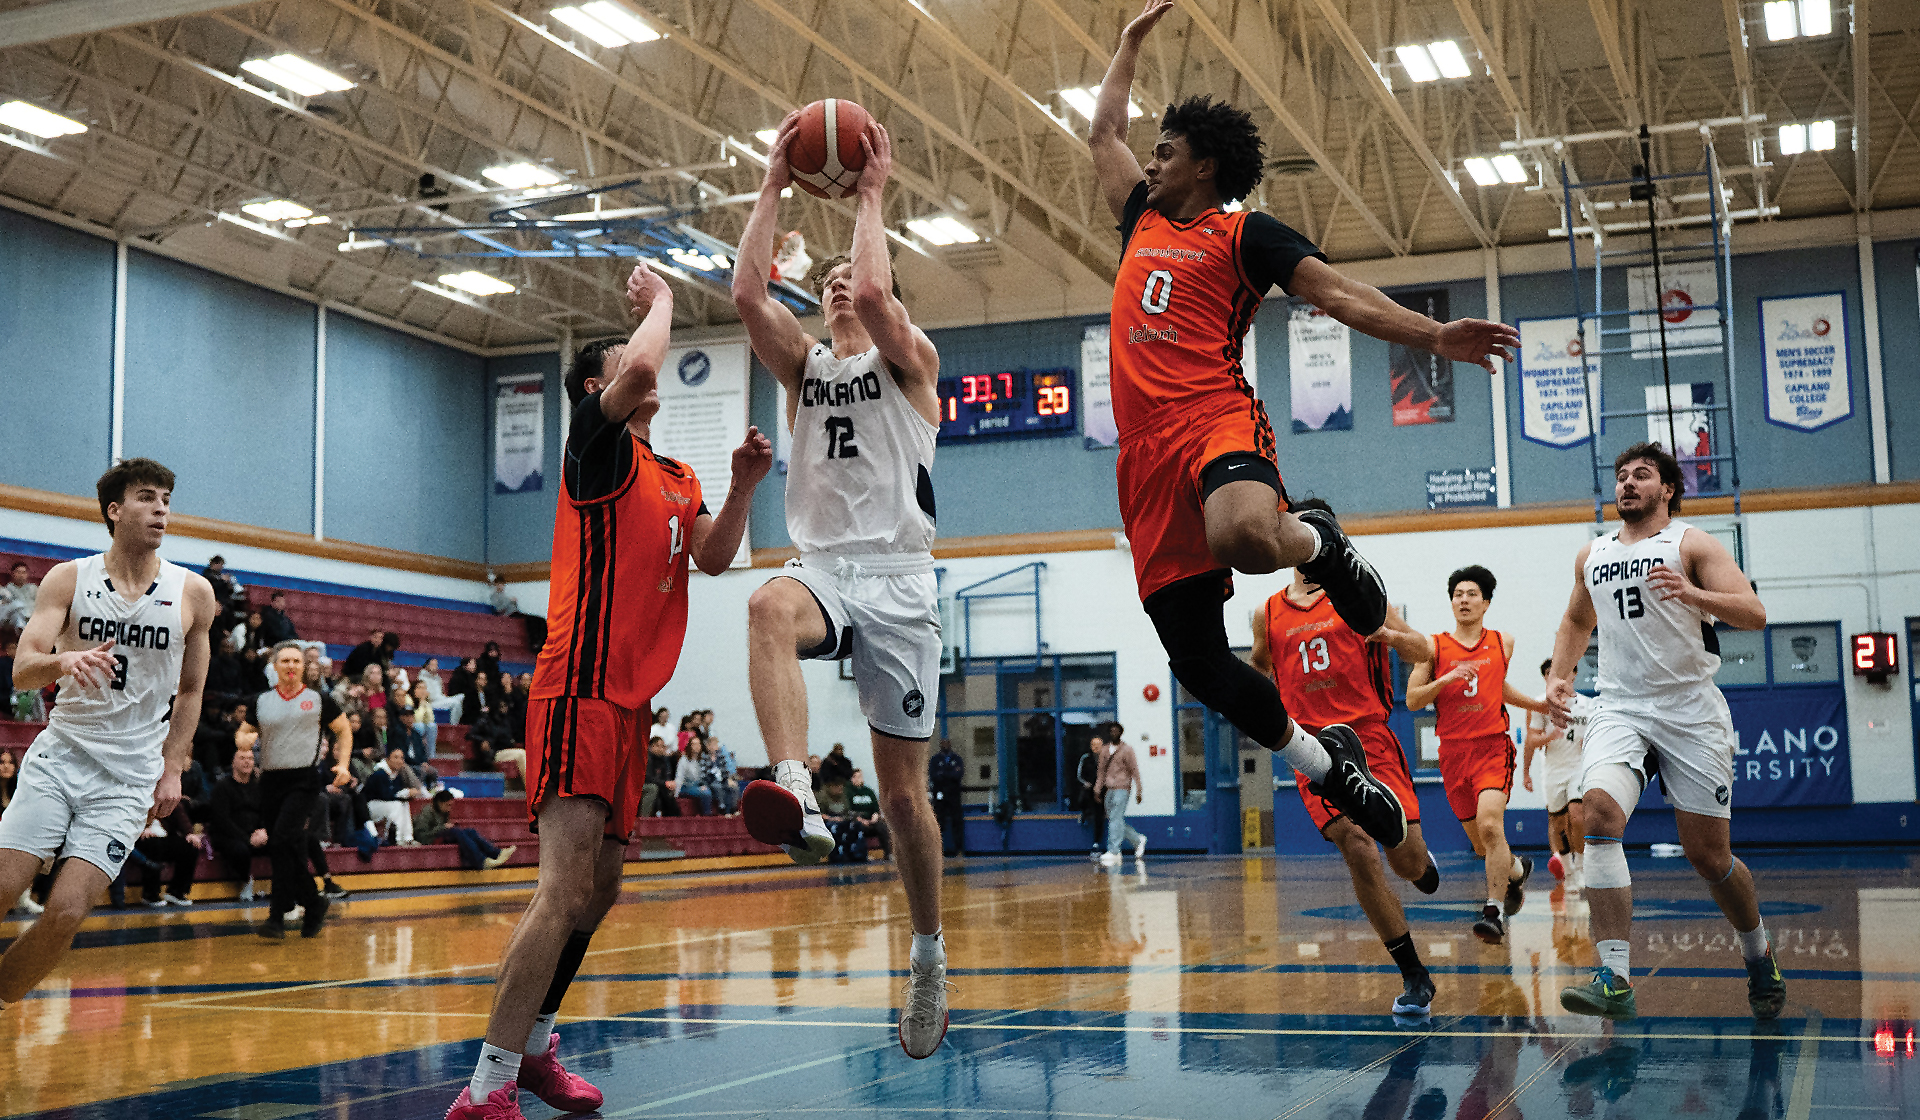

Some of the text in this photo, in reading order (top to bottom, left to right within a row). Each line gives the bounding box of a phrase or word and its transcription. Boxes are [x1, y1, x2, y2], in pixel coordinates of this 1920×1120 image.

[1141, 269, 1174, 315] 0
[1804, 345, 1835, 356] SOCCER
[1779, 356, 1834, 368] SUPREMACY
[1566, 364, 1598, 375] SOCER
[1785, 381, 1830, 393] CAPILANO
[1789, 393, 1827, 404] COLLEGE
[1541, 400, 1583, 411] CAPILANO
[1544, 411, 1580, 421] COLLEGE
[824, 416, 859, 459] 12
[1613, 586, 1645, 619] 13
[79, 616, 170, 650] CAPILANO
[1298, 636, 1331, 674] 13
[1856, 636, 1895, 668] 21
